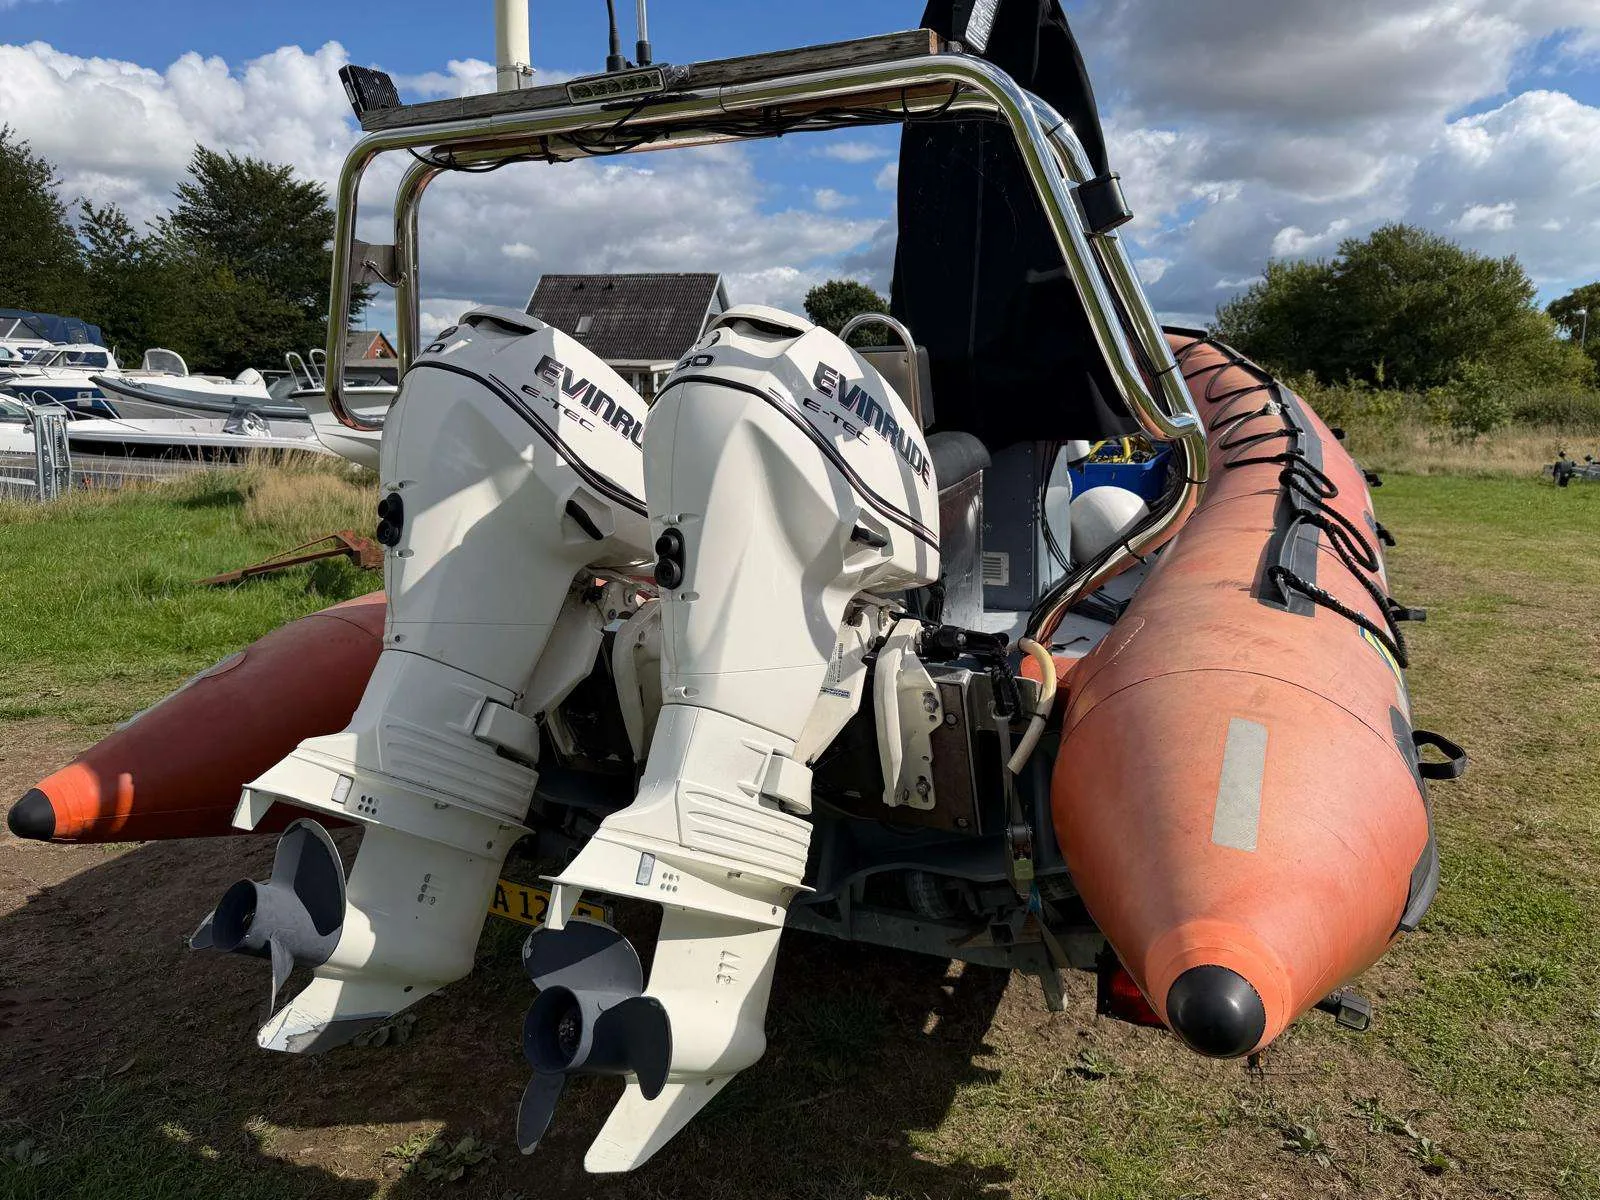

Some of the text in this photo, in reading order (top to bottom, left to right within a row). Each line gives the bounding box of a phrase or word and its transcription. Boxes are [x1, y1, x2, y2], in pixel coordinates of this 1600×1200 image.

[520, 384, 596, 433] E-TEC
[534, 354, 643, 452] EVINRU
[802, 397, 870, 446] E-TEC
[812, 361, 931, 490] EVINRUDE
